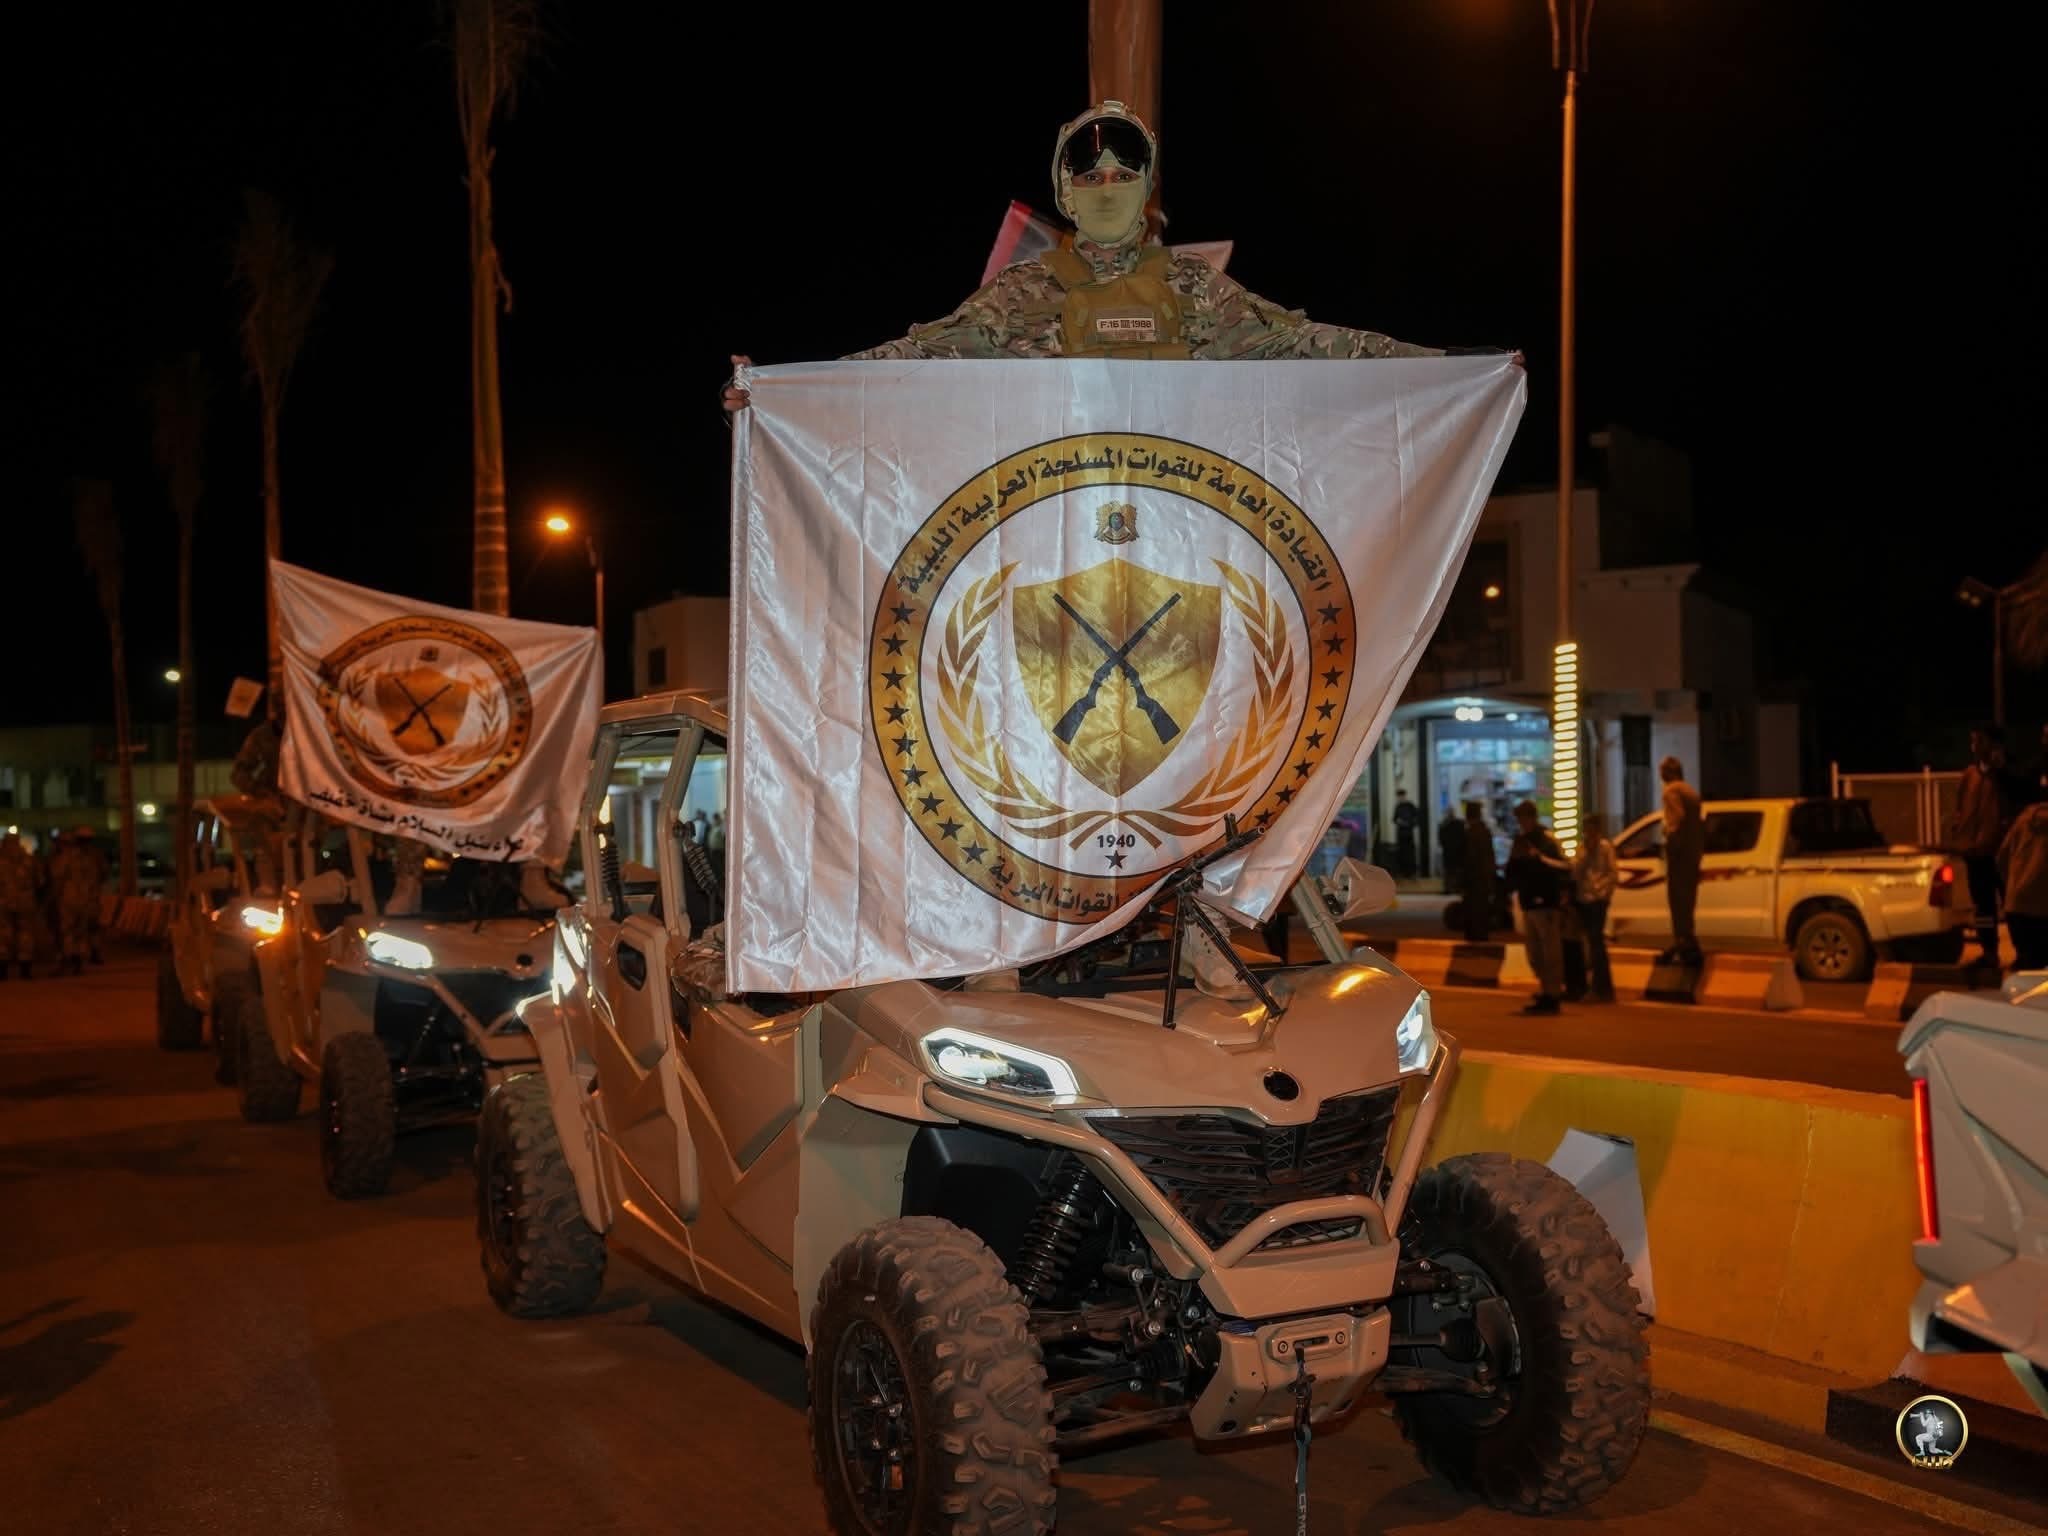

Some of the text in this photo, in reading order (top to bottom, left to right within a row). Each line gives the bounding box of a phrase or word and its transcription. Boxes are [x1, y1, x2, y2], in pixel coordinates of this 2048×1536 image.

[897, 446, 1332, 593] القيادة العامة للقوات المسلحة العربية الليبية
[1096, 834, 1136, 849] 1940
[988, 855, 1120, 917] القوات البرية
